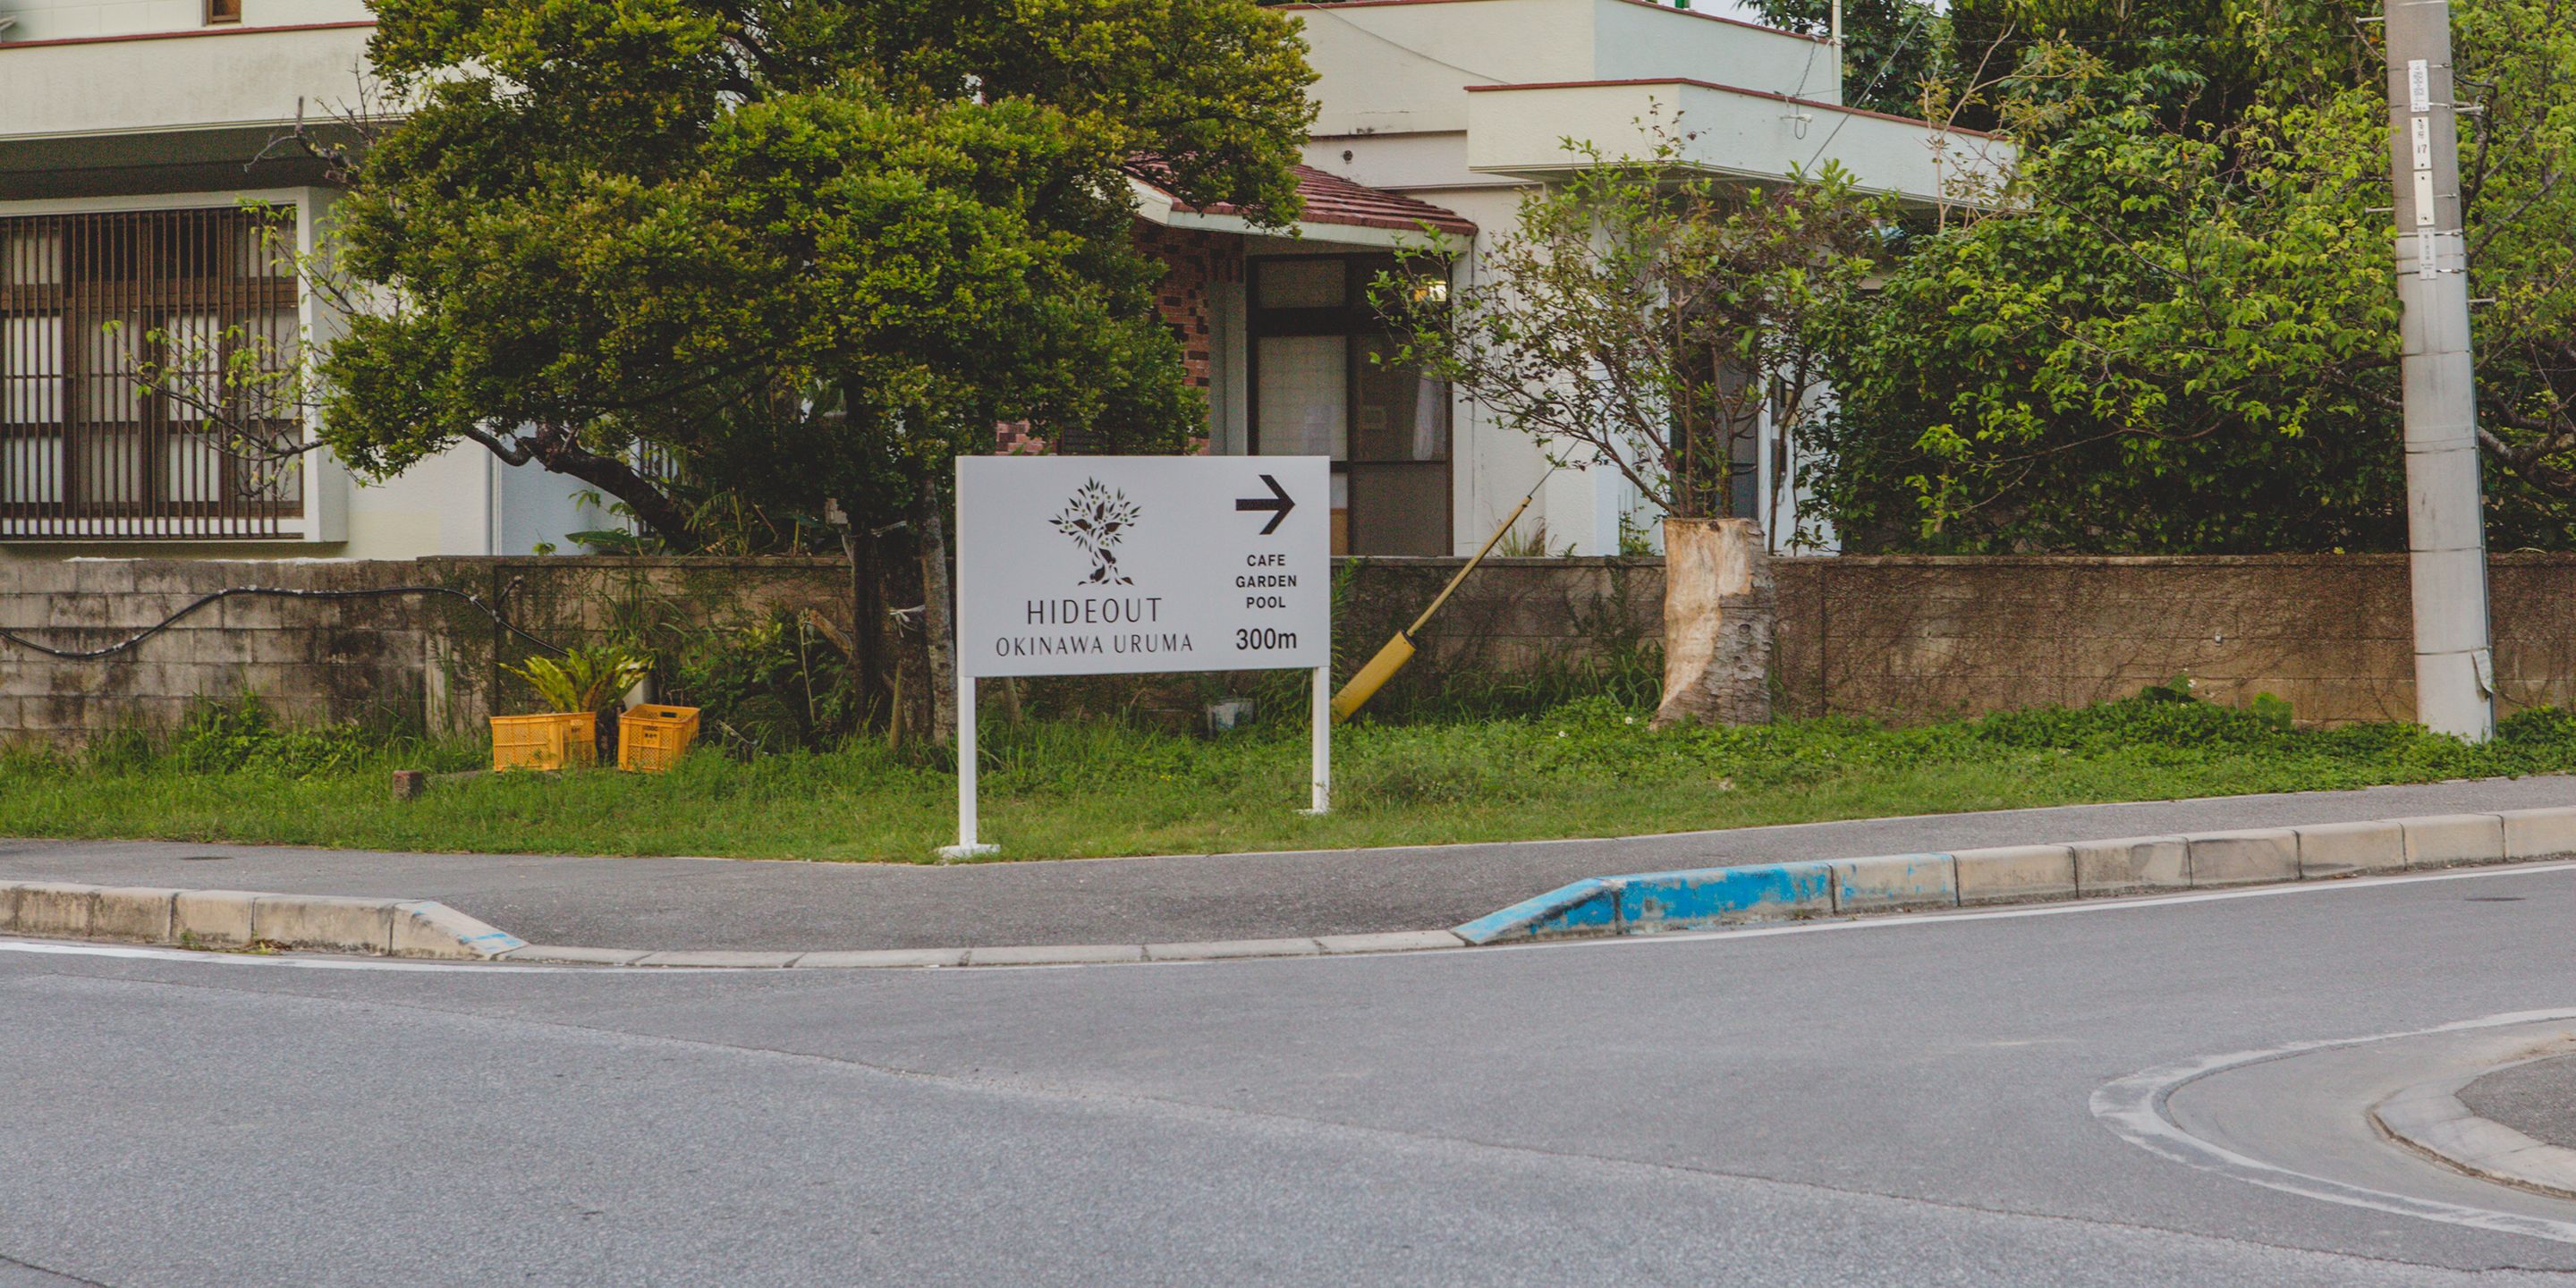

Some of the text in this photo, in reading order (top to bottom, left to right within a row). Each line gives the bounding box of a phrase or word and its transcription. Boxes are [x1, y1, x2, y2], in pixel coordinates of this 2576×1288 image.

[1246, 554, 1286, 567] CAFE
[1235, 574, 1297, 589] GARDEN
[1027, 597, 1163, 625] HIDEOUT
[1246, 596, 1286, 609] POOL
[996, 633, 1193, 657] OKINAWA URUMA
[1235, 627, 1297, 651] 300m
